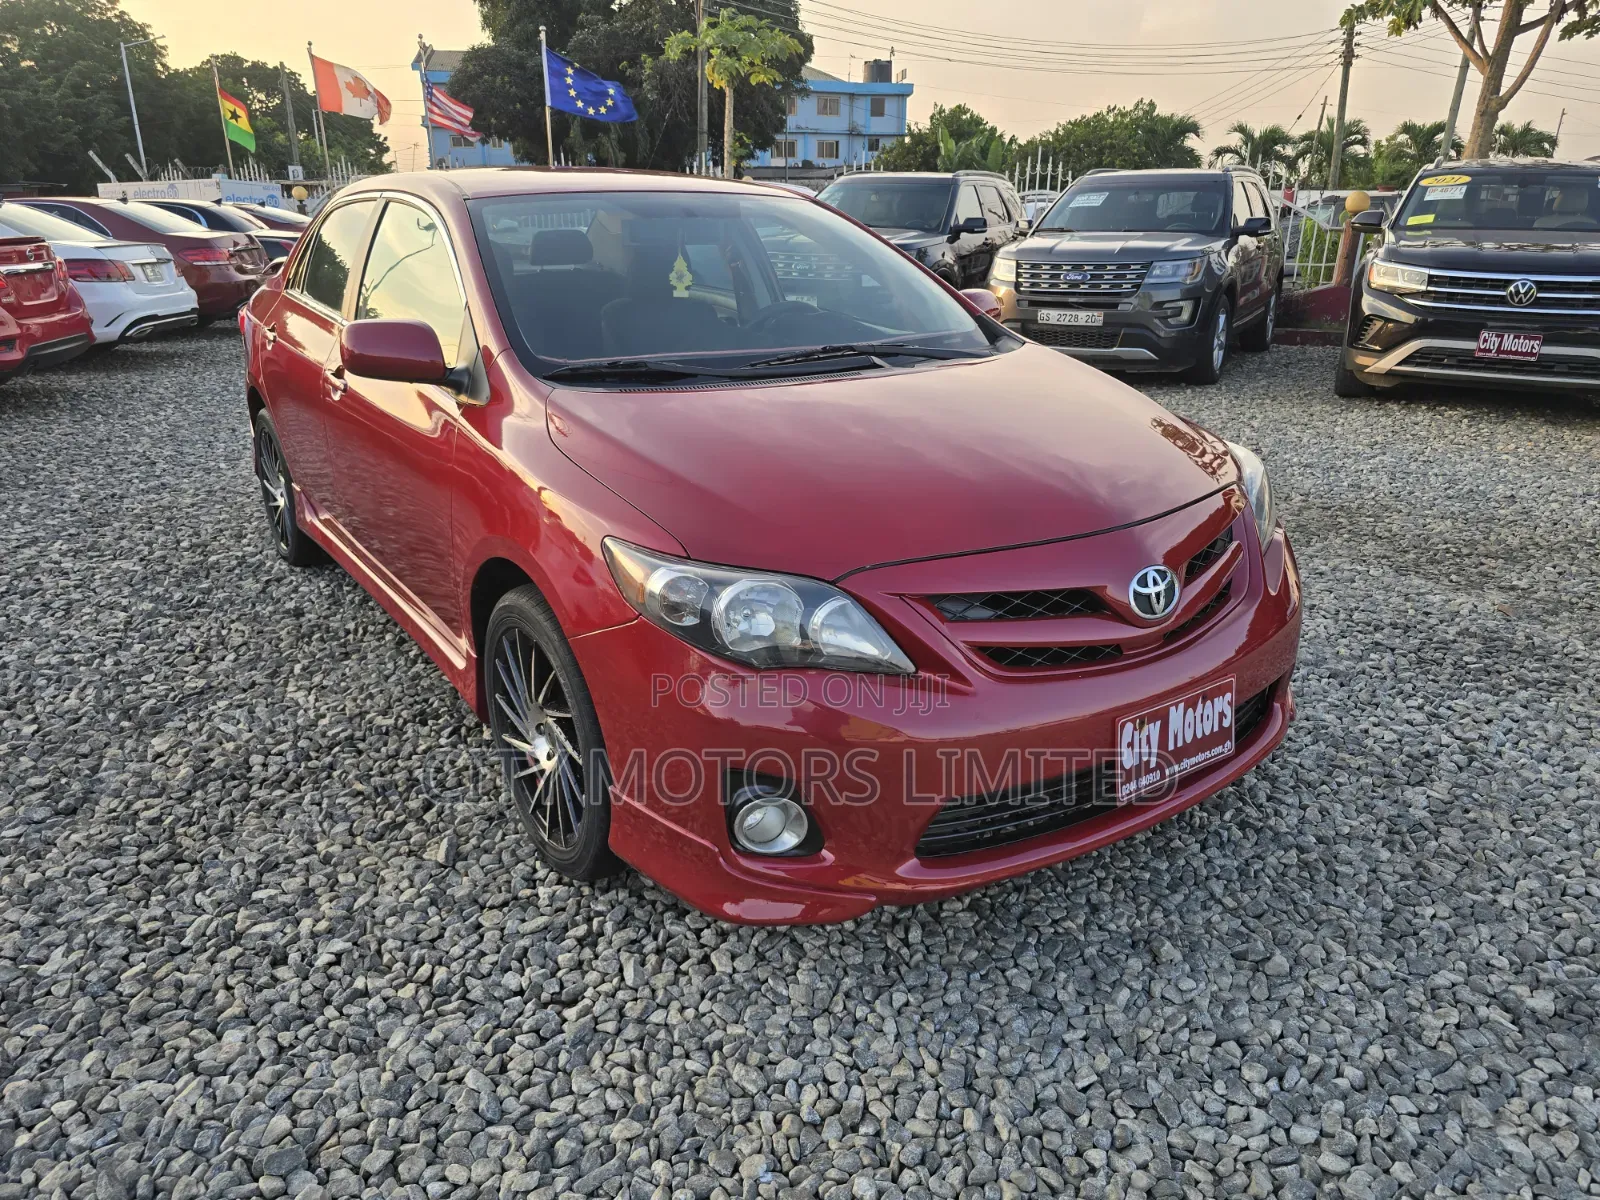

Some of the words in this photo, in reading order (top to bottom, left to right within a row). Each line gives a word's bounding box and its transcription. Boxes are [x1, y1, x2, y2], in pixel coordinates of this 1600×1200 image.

[133, 187, 166, 199] electro
[1039, 312, 1051, 321] GS
[1479, 332, 1502, 353] City
[1500, 334, 1540, 353] Motors
[1121, 716, 1162, 770] City
[1167, 692, 1232, 751] Motors
[1165, 739, 1232, 777] www.citymotors.com.gh
